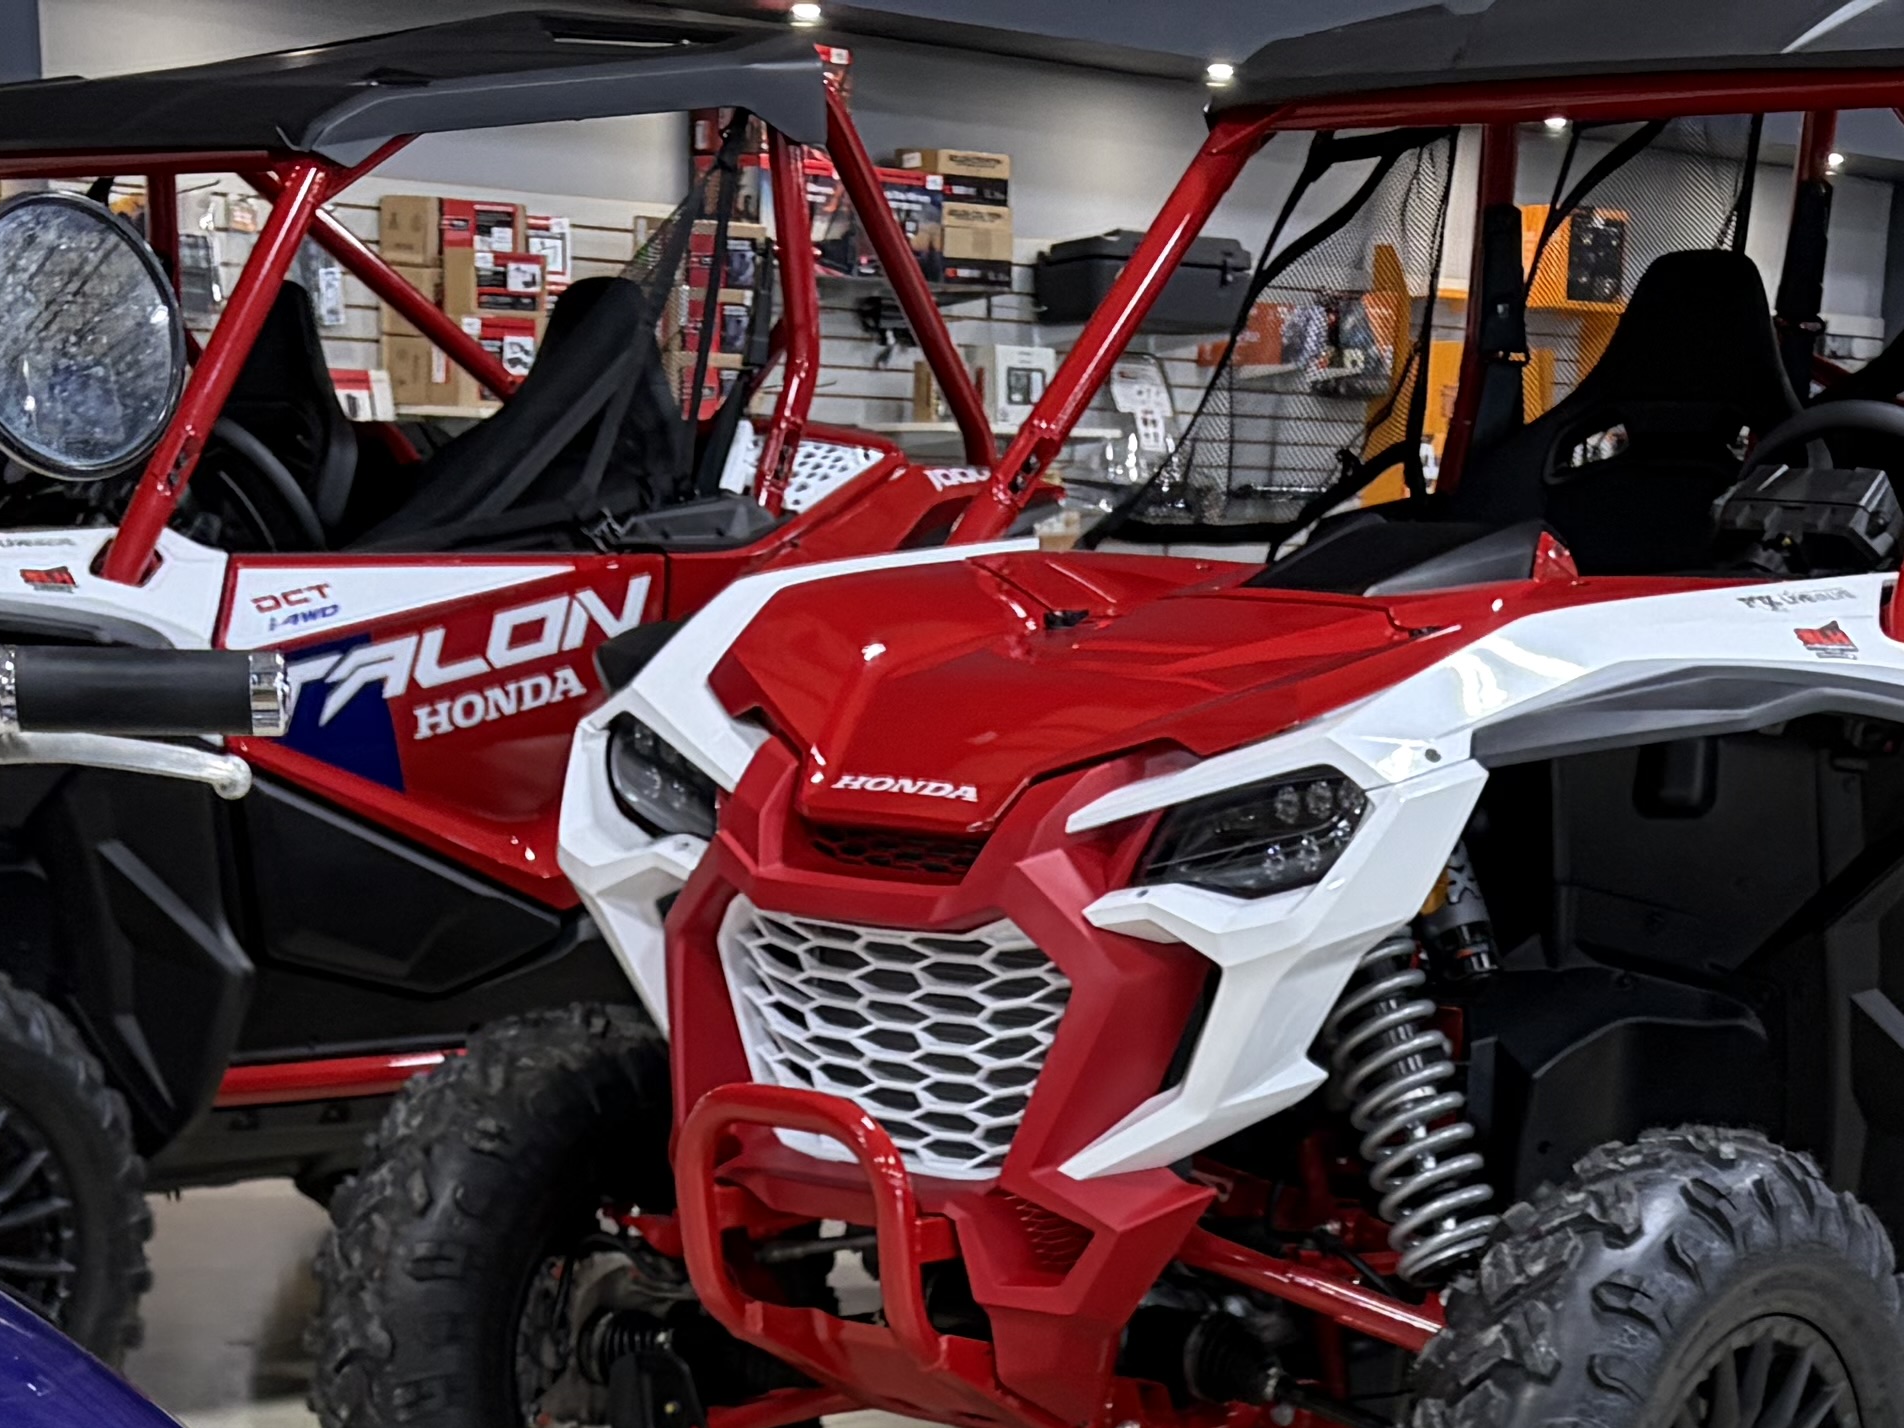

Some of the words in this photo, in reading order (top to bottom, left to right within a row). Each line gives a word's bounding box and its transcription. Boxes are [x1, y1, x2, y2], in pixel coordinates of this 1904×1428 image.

[250, 583, 330, 613] DCT
[284, 573, 652, 728] TALON
[413, 664, 587, 740] HONDA
[831, 774, 979, 803] HONDA
